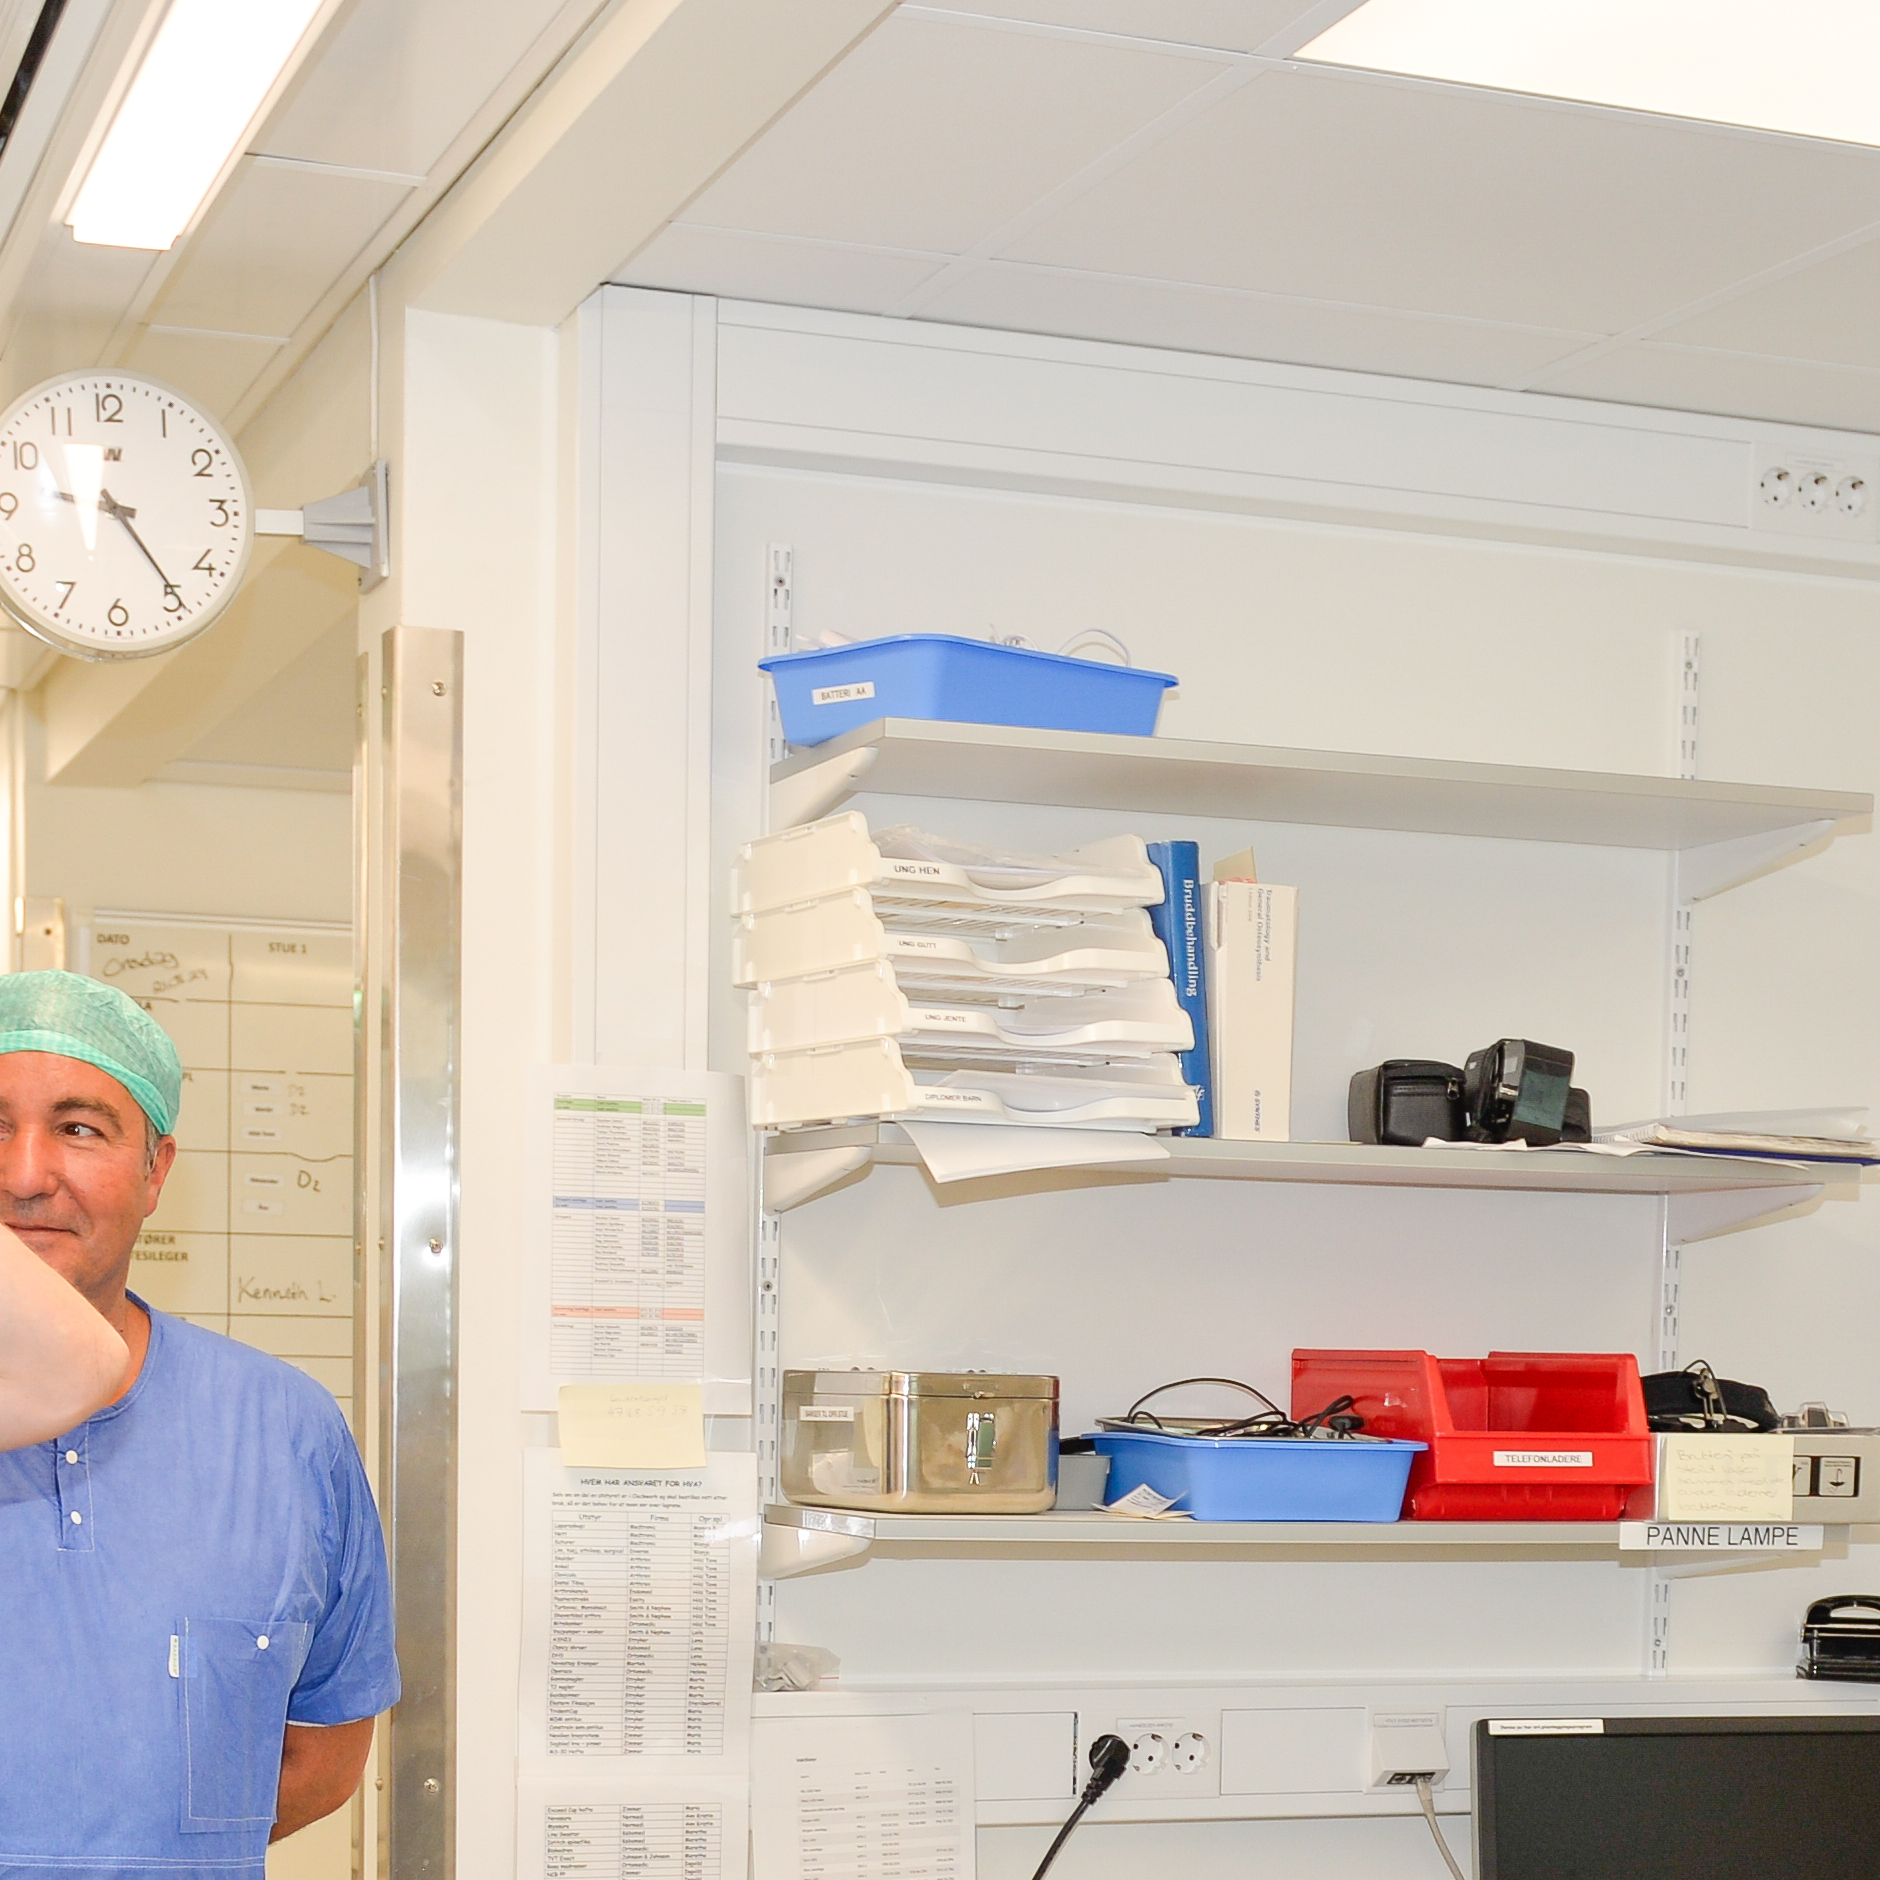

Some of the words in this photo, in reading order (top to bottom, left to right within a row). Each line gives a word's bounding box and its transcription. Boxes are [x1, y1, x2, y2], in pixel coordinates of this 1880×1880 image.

[51, 406, 72, 436] 11
[96, 393, 124, 422] 12
[161, 409, 166, 438] 1
[14, 441, 38, 470] 10
[191, 448, 213, 477] 2
[209, 499, 229, 527] 3
[16, 544, 35, 572] 8
[192, 549, 216, 577] 4
[55, 581, 76, 609] 7
[163, 585, 182, 612] 5
[108, 599, 129, 626] 6
[821, 689, 851, 700] BATTERI
[856, 687, 866, 695] AA
[894, 865, 916, 874] UNG
[97, 934, 129, 945] DATO
[269, 942, 296, 953] STUE
[302, 945, 306, 954] 1
[1183, 879, 1197, 997] Bruddbehandling
[139, 1234, 176, 1244] TØRER
[131, 1251, 189, 1261] TESILEGER
[237, 1276, 309, 1303] Kenneth
[1505, 1454, 1583, 1464] TELEFONLADERE
[1647, 1526, 1720, 1546] PANNE
[1728, 1526, 1799, 1546] LAMPE
